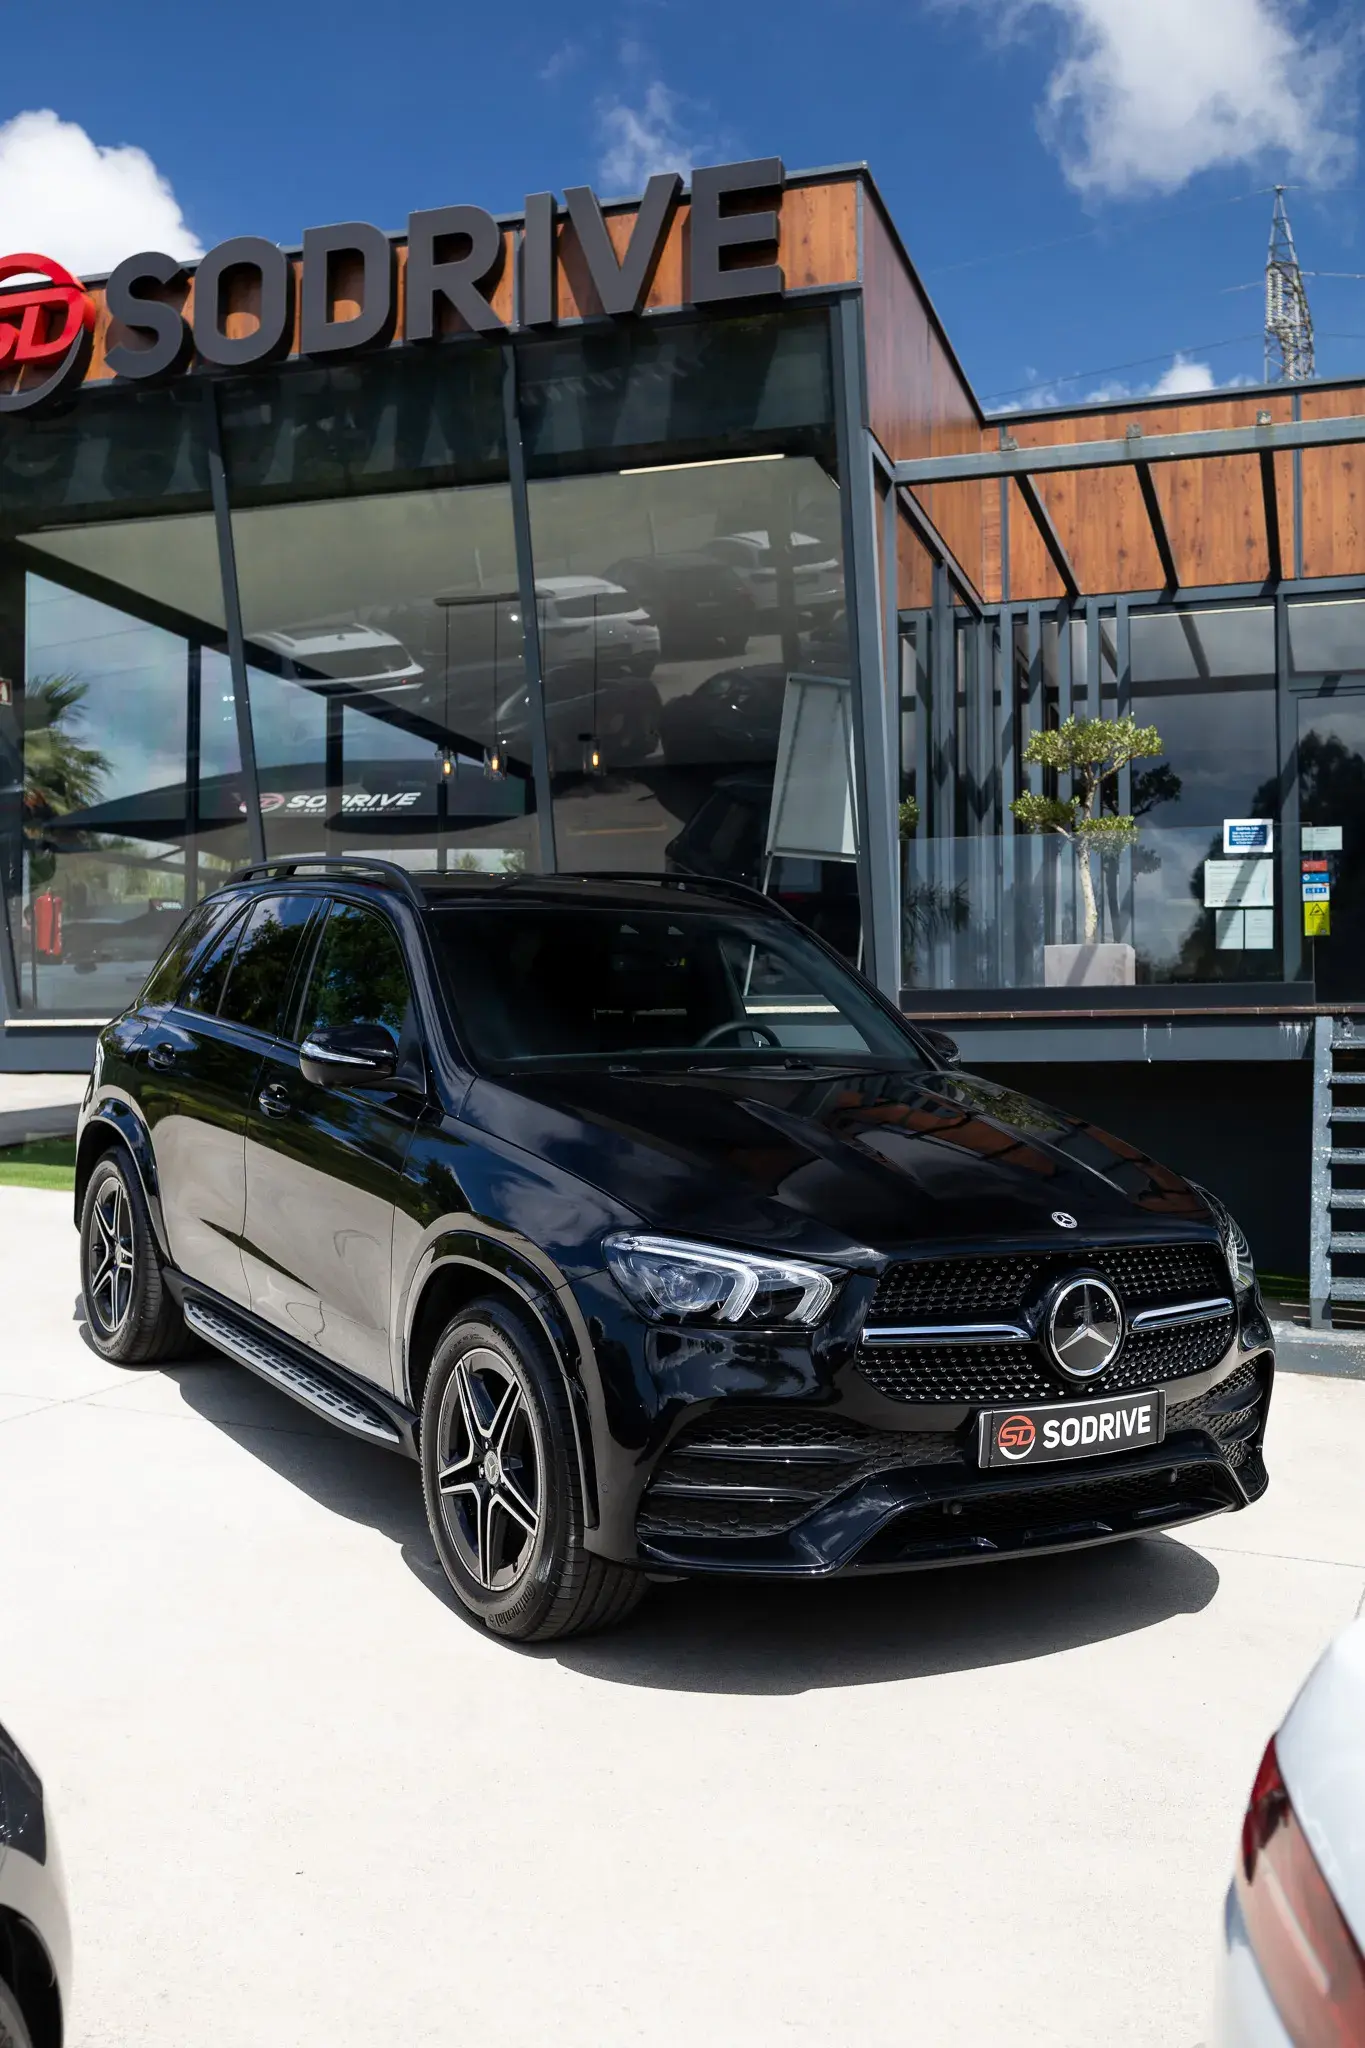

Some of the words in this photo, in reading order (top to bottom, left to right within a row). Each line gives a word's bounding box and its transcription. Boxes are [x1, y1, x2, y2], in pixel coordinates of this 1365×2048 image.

[104, 156, 785, 379] SODRIVE
[999, 1424, 1036, 1447] SD
[1042, 1404, 1151, 1449] SODRIVE
